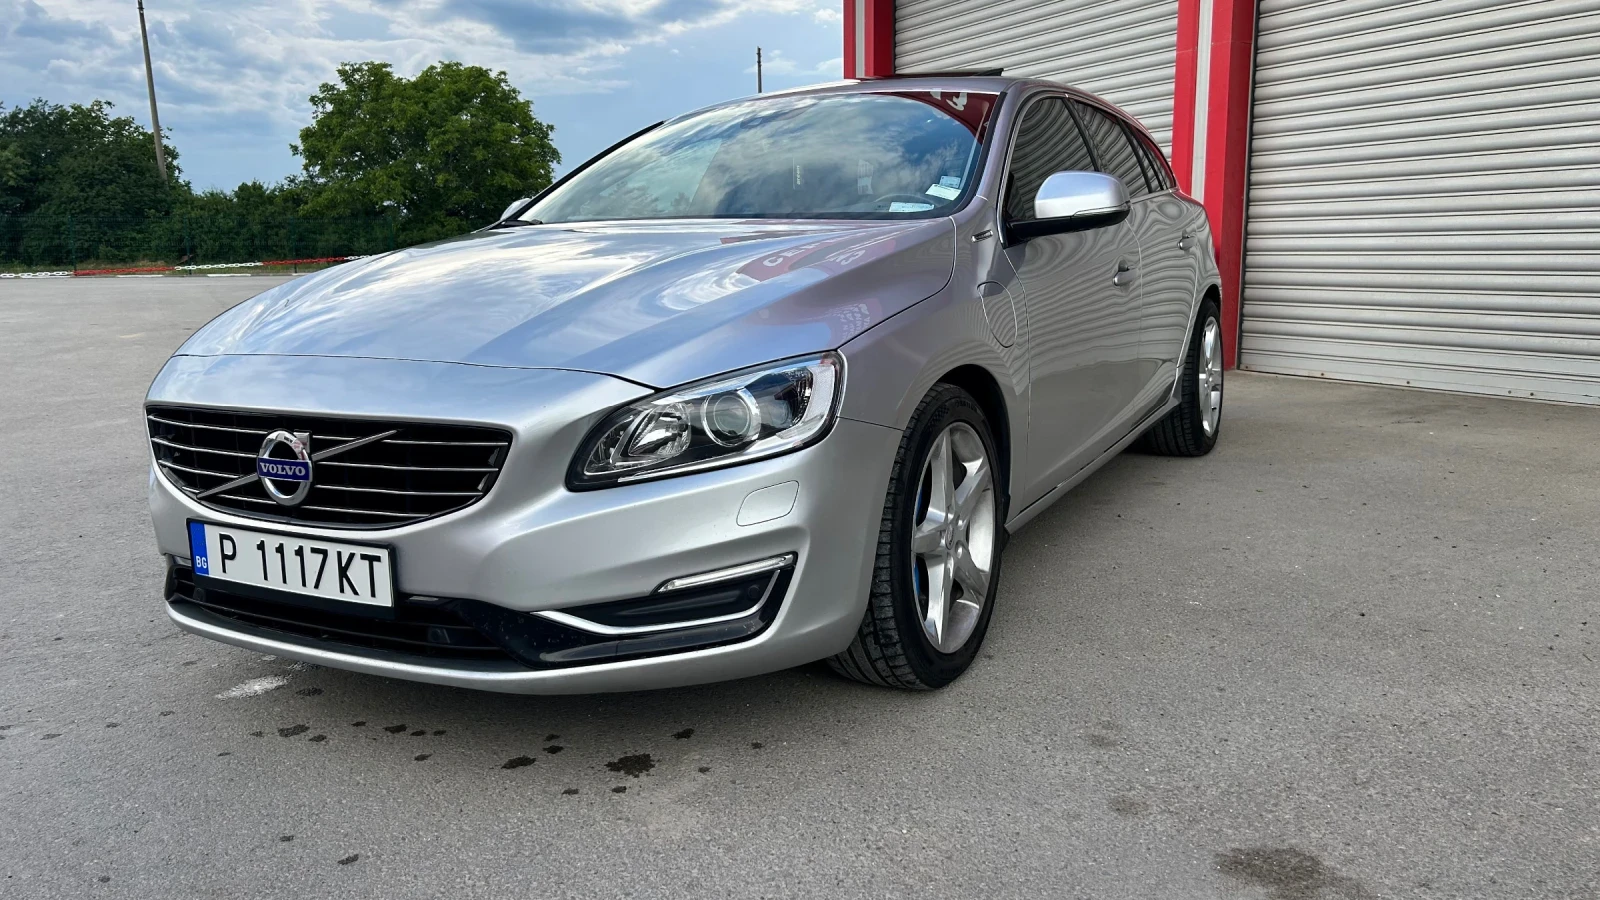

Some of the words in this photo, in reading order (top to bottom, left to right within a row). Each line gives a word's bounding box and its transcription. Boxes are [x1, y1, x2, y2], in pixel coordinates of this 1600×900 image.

[259, 463, 306, 476] VOLVO
[218, 532, 237, 574] P
[195, 555, 208, 569] BG
